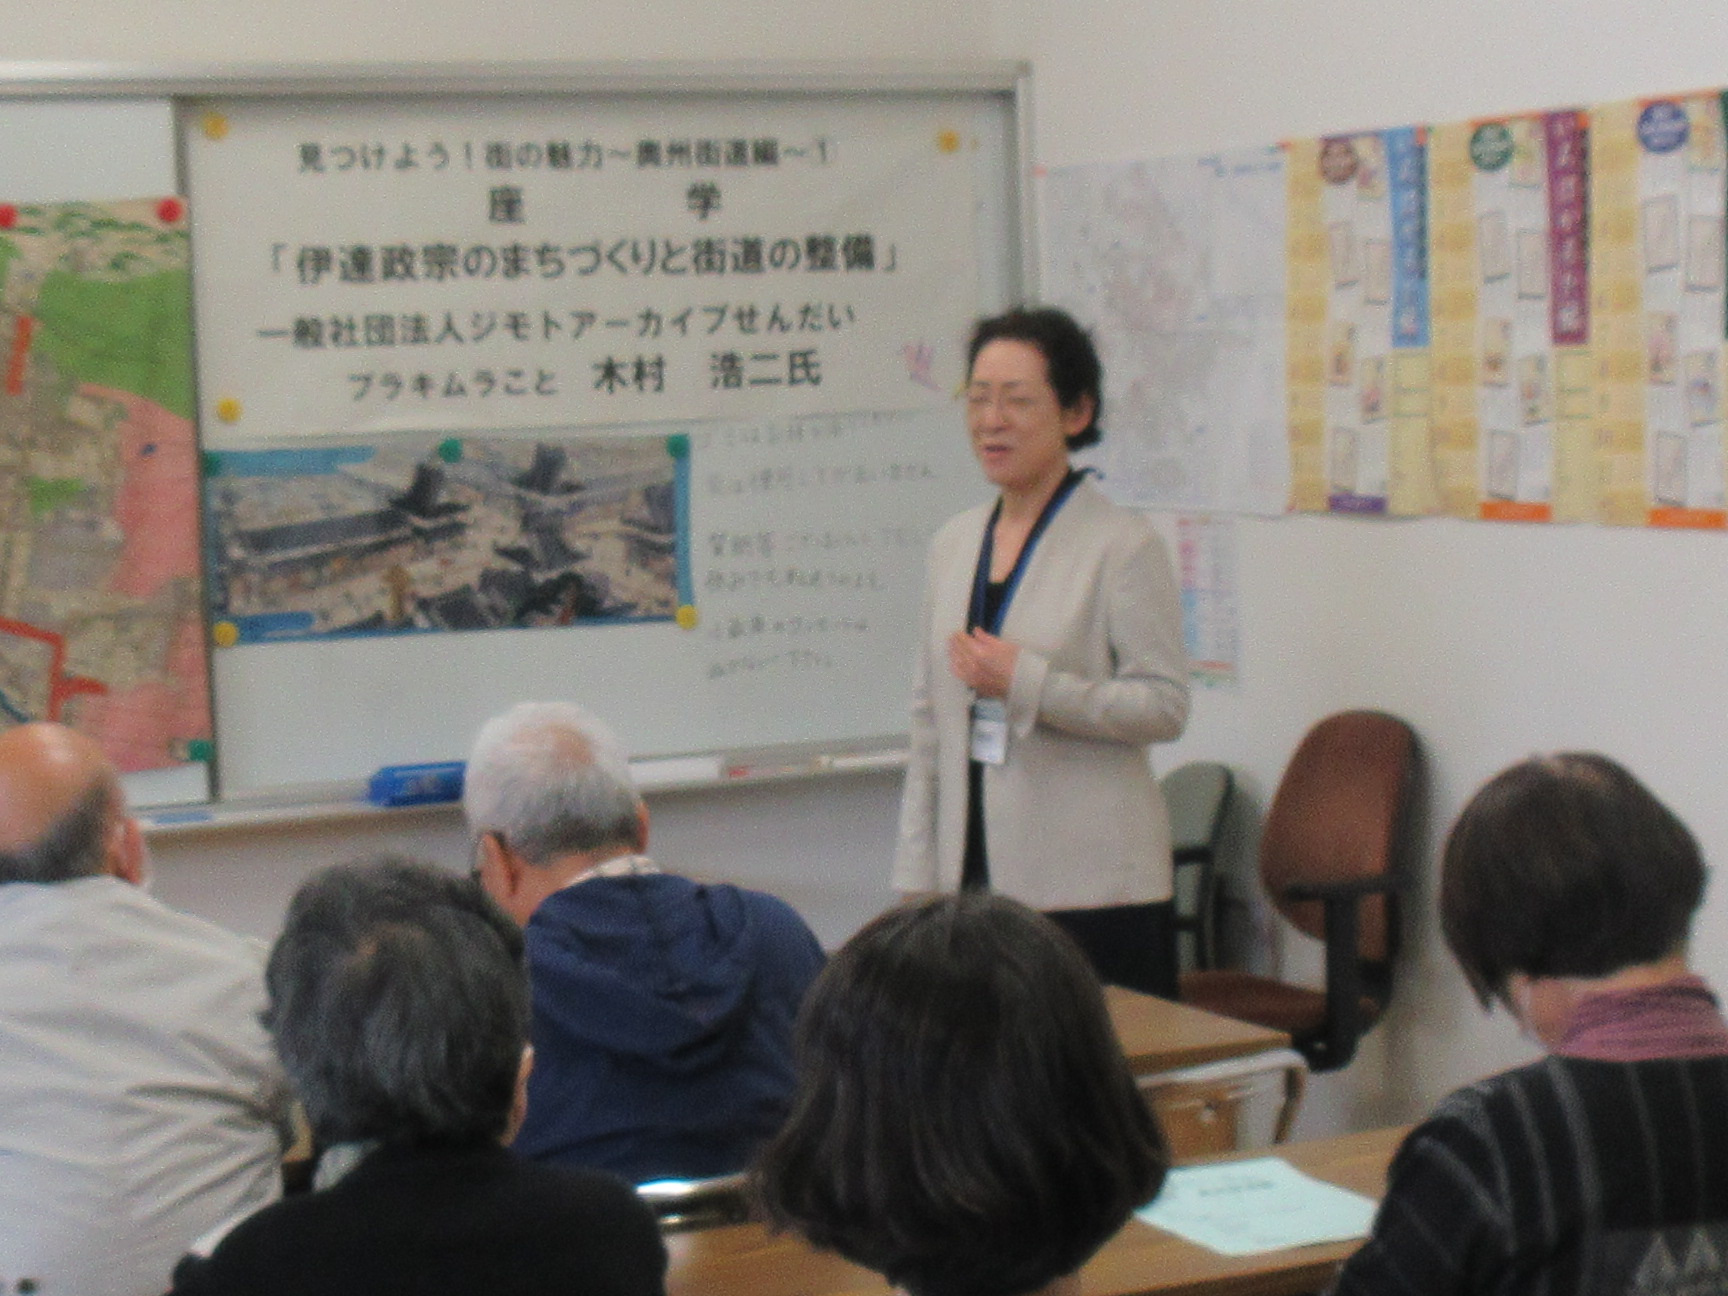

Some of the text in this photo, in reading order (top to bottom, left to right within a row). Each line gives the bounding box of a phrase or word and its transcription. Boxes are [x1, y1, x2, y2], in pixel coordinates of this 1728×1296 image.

[487, 180, 723, 223] 座 学
[591, 354, 666, 394] 木村
